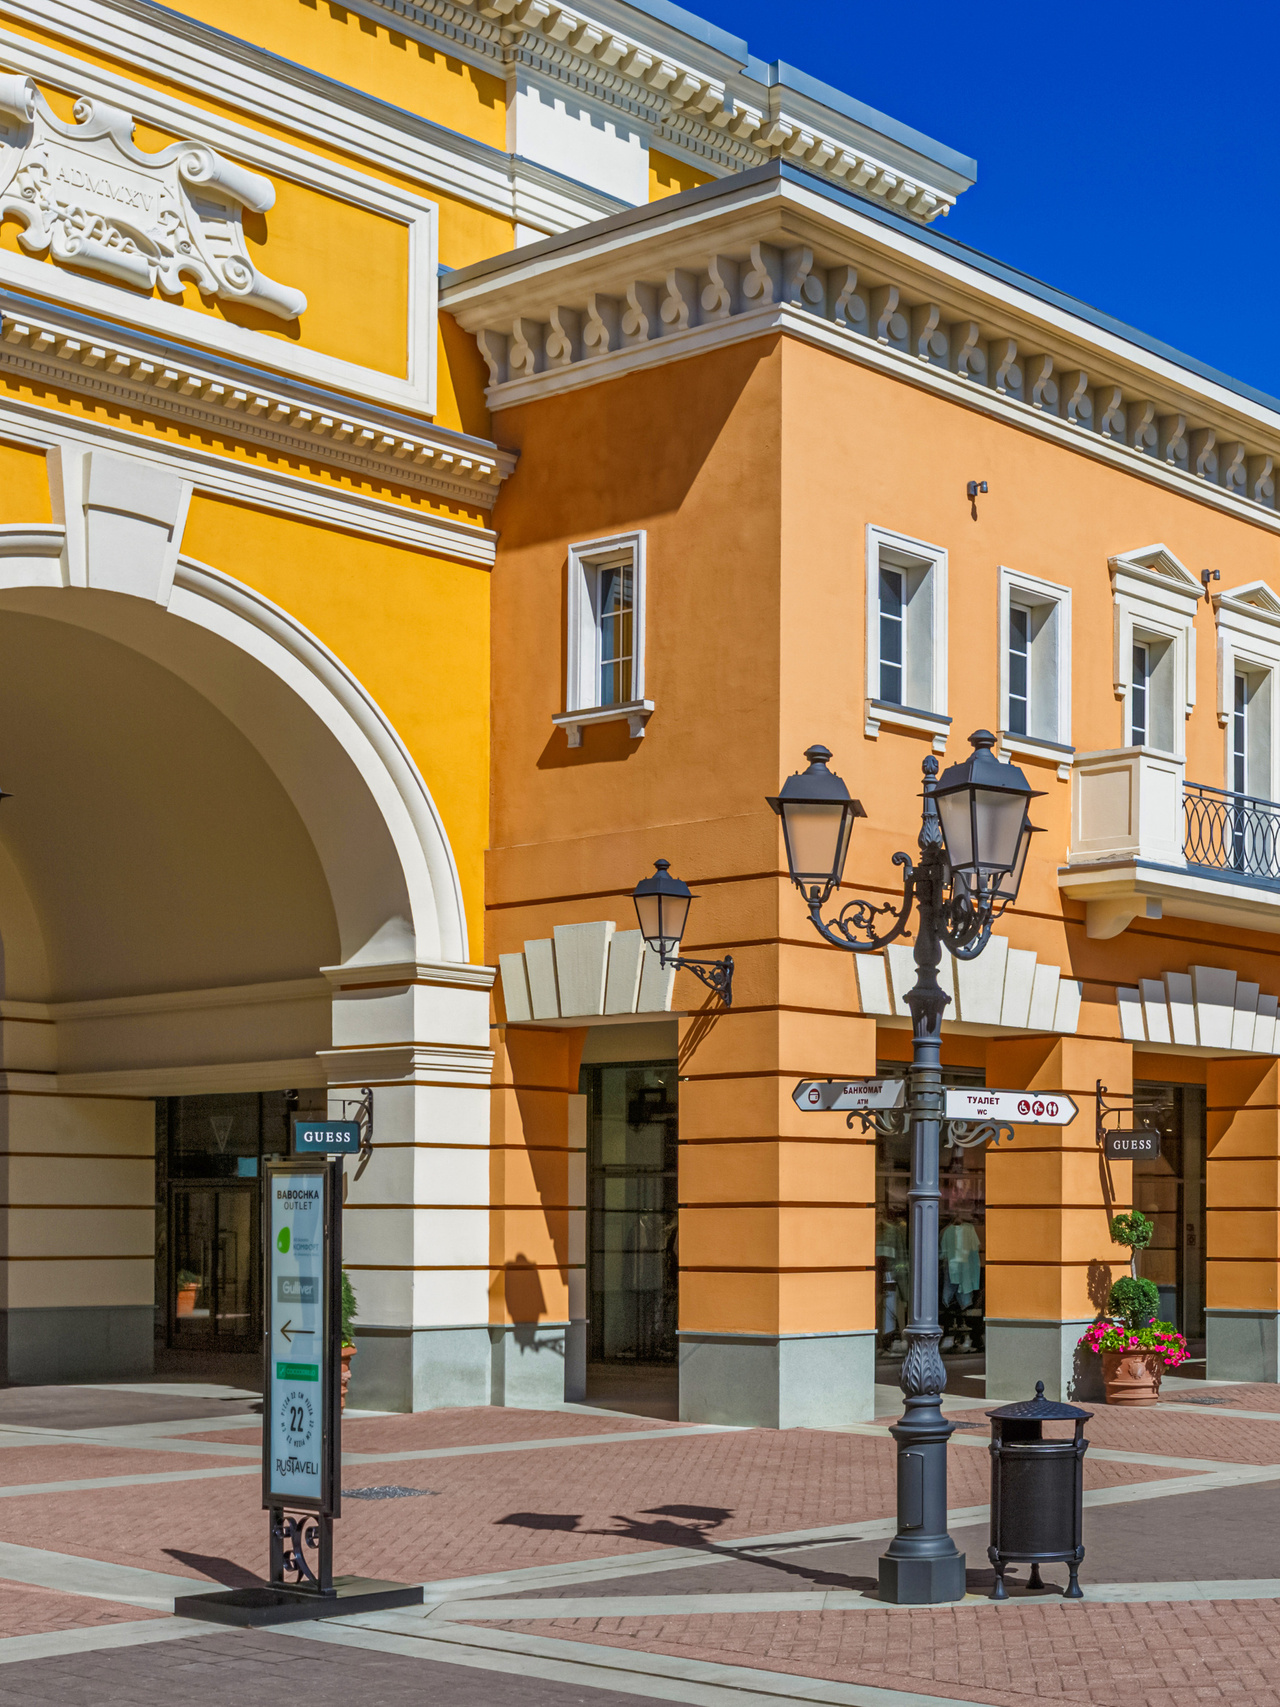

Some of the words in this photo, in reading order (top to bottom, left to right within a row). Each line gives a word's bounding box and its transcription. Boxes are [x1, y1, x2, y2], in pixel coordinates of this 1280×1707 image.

[843, 1085, 883, 1095] БАНКОМАТ
[967, 1096, 1001, 1105] ТУАЛЕТ
[303, 1131, 351, 1143] GUESS
[1113, 1139, 1152, 1150] GUESS
[277, 1190, 319, 1200] BABOCHKA
[284, 1201, 312, 1210] OUTLET
[282, 1280, 314, 1295] Gulliver
[290, 1406, 304, 1433] 22
[276, 1456, 319, 1476] RUSTAVELI
